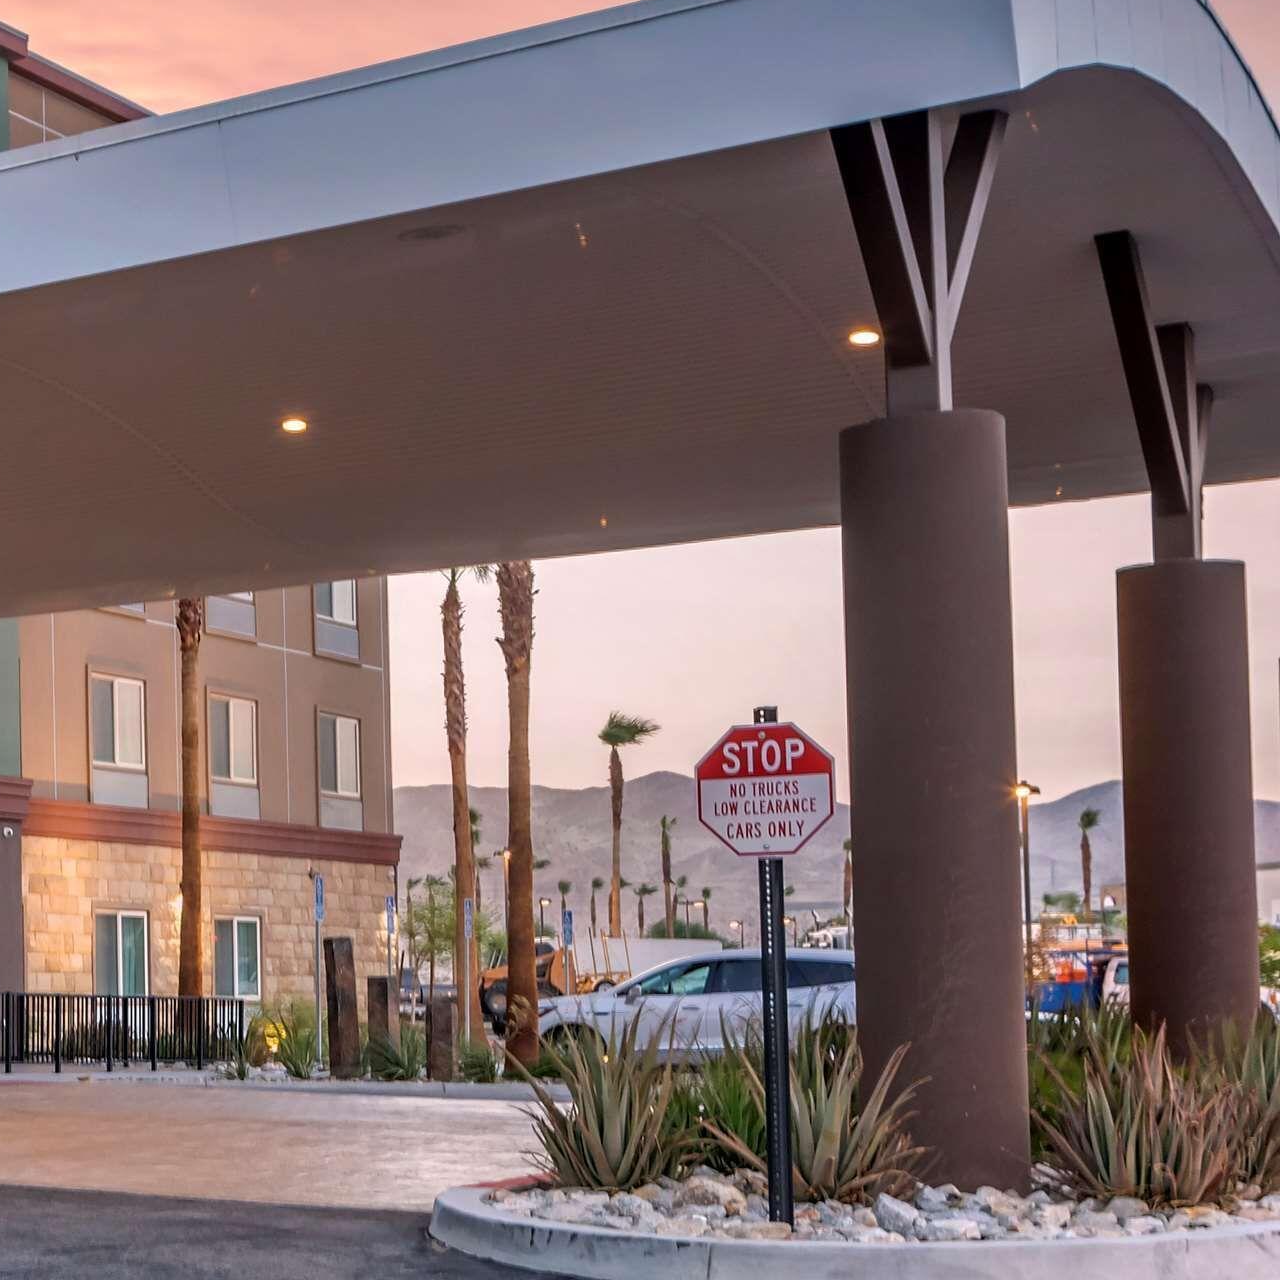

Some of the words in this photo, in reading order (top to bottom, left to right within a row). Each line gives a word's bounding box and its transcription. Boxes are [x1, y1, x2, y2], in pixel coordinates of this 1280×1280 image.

[722, 738, 805, 774] STOP
[729, 784, 746, 798] NO
[752, 780, 800, 797] TRUCKS
[714, 800, 738, 817] LOW
[744, 798, 817, 815] CLEARANCE
[726, 822, 762, 839] CARS
[768, 820, 805, 837] ONLY
